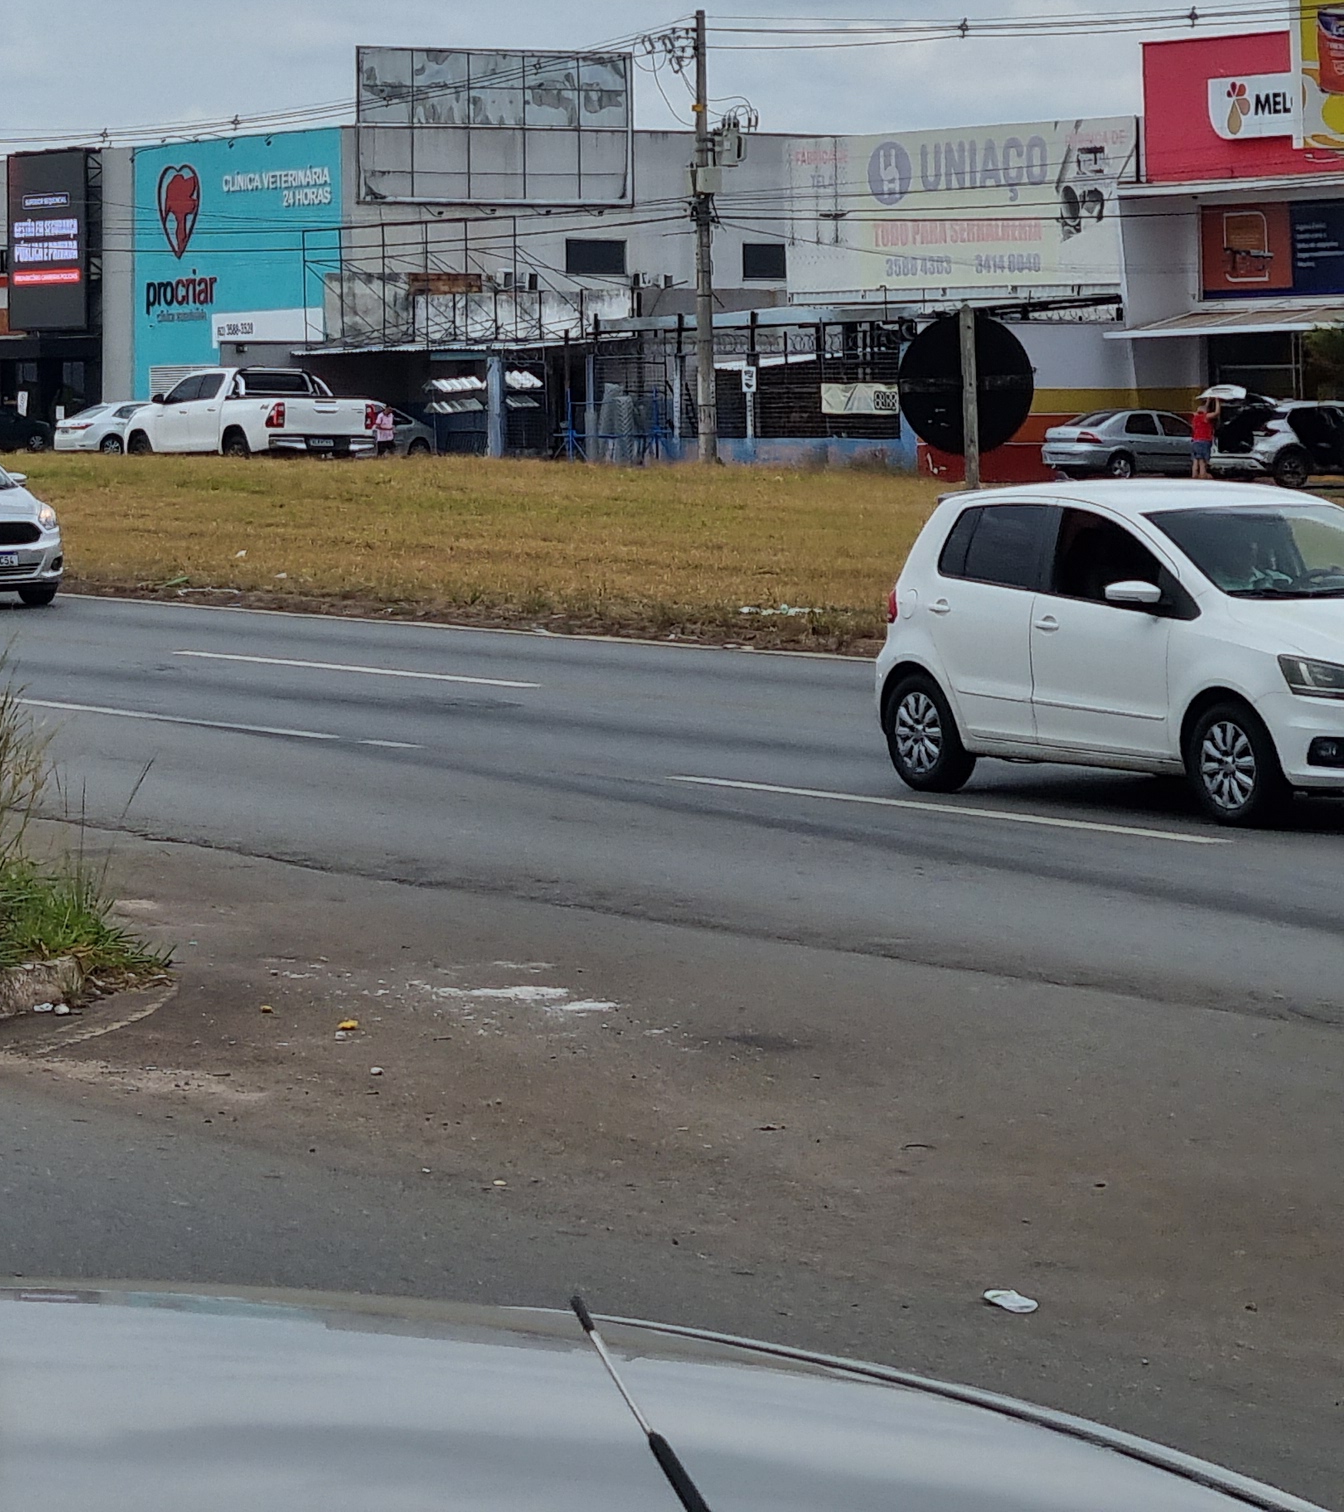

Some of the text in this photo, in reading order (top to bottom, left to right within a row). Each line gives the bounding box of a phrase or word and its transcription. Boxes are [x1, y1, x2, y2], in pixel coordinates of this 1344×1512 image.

[1254, 92, 1293, 116] MEL
[222, 165, 330, 192] CLÍNICA VETERINÁRIA
[920, 135, 1048, 202] UNIAÇO
[283, 186, 332, 206] 24 HORAS
[146, 269, 217, 315] procriar
